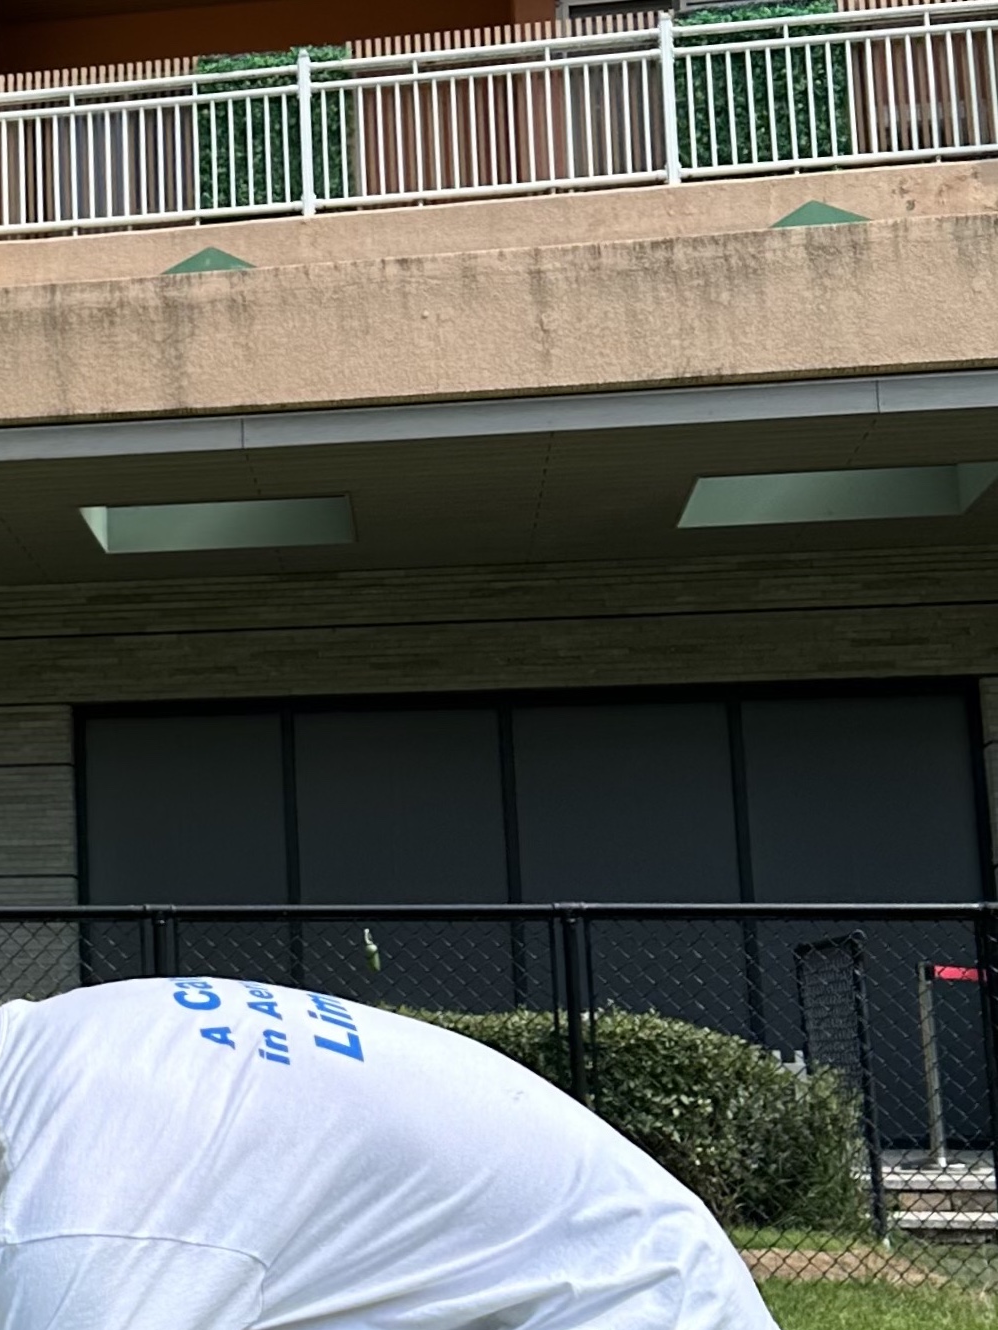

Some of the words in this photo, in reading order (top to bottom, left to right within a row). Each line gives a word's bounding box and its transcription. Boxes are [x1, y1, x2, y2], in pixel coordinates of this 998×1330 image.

[171, 978, 222, 1011] Ca
[199, 1026, 236, 1050] A
[258, 1028, 291, 1066] in
